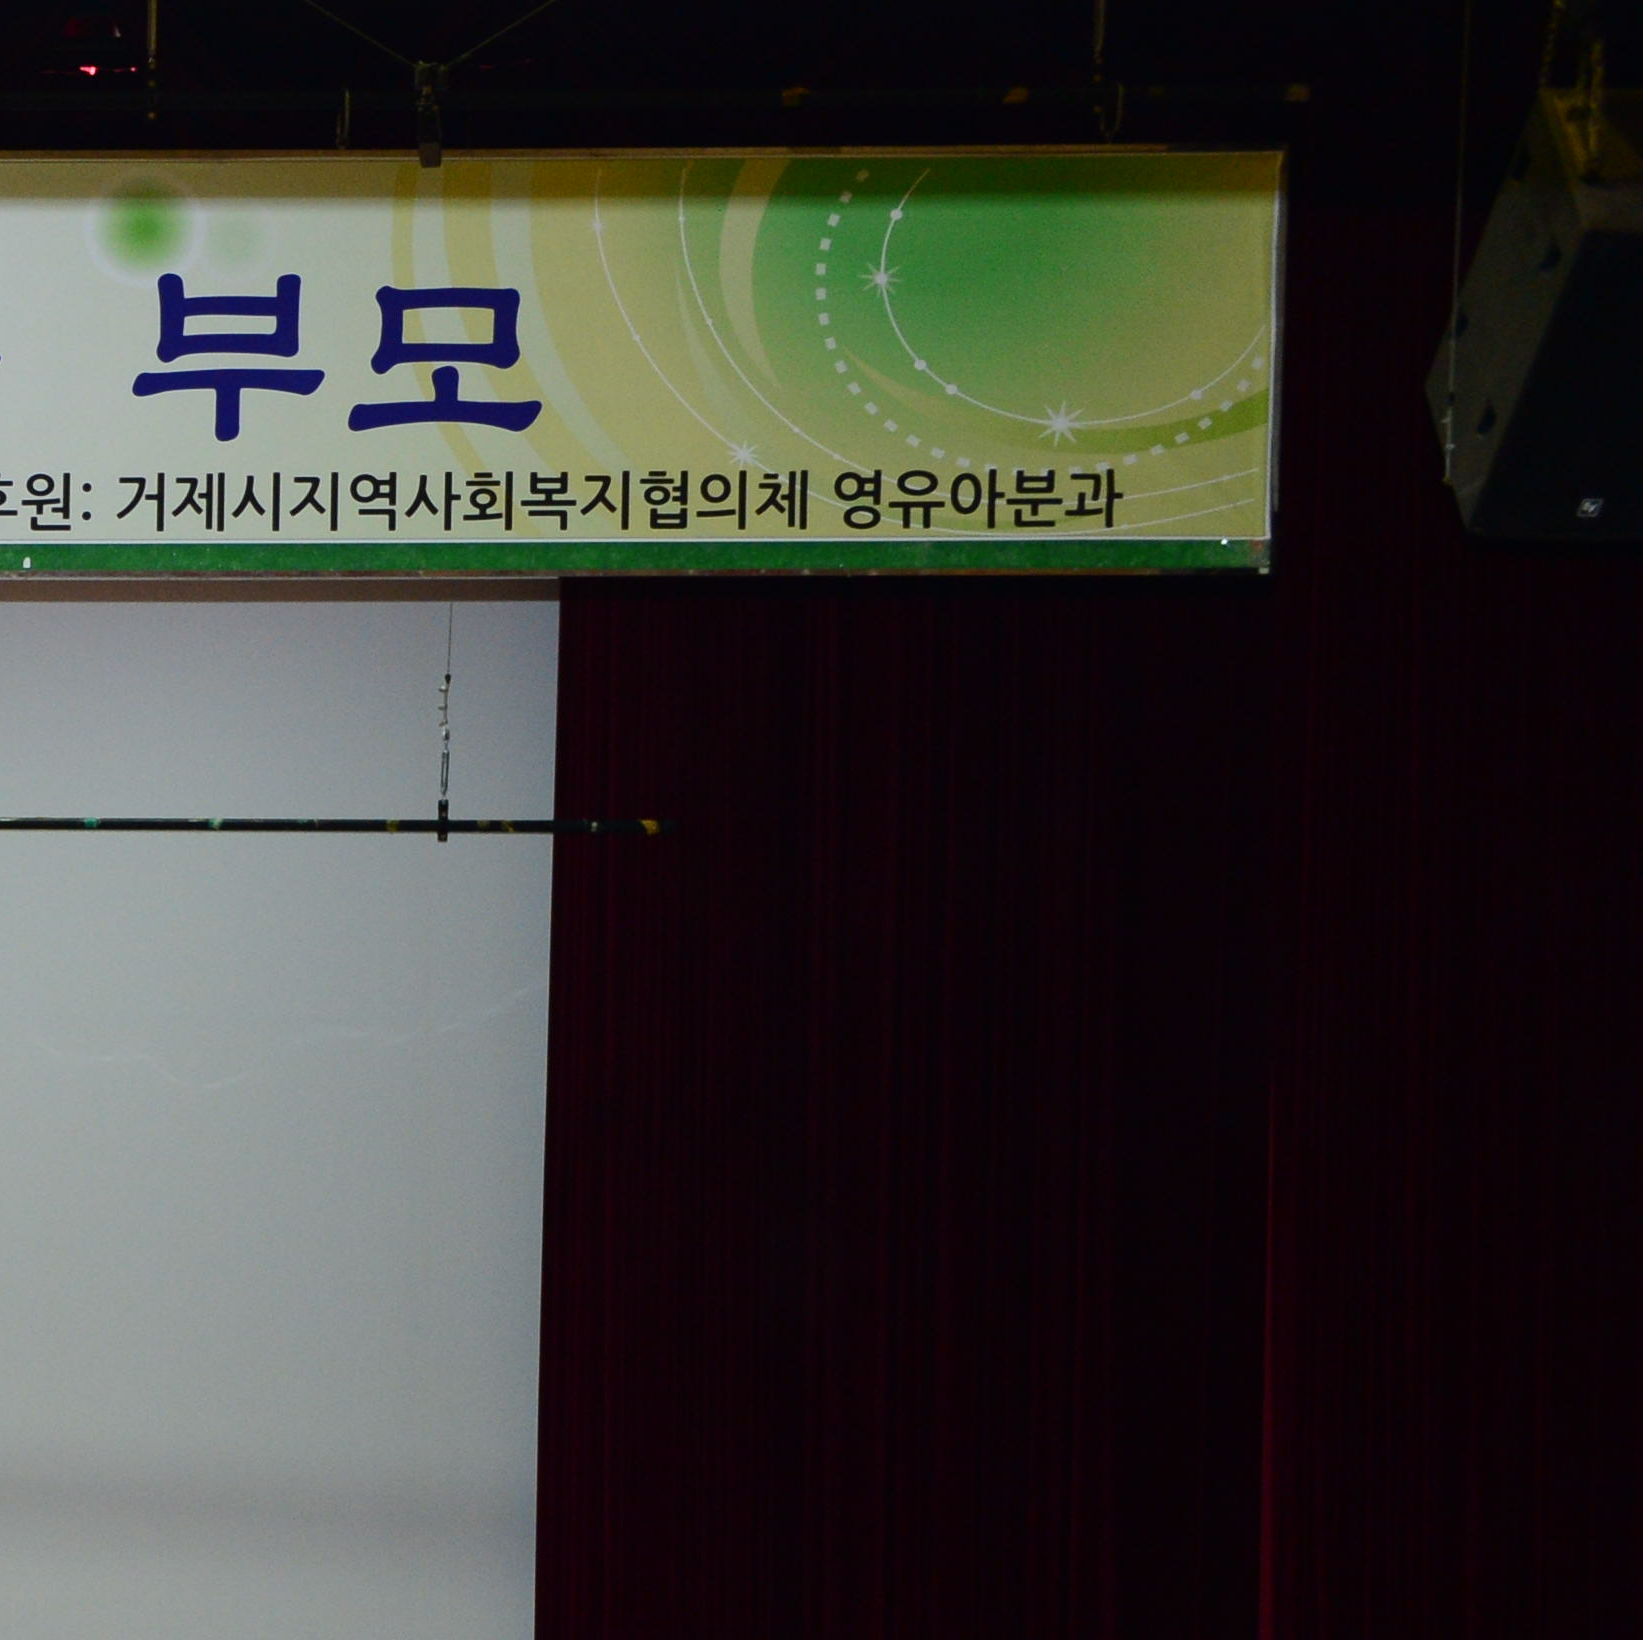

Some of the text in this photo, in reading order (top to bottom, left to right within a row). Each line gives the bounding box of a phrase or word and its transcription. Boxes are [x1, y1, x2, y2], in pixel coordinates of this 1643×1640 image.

[132, 273, 543, 442] 부모
[117, 469, 809, 532] 거제시지역사회복지협의체
[834, 468, 1124, 530] 영유아분과
